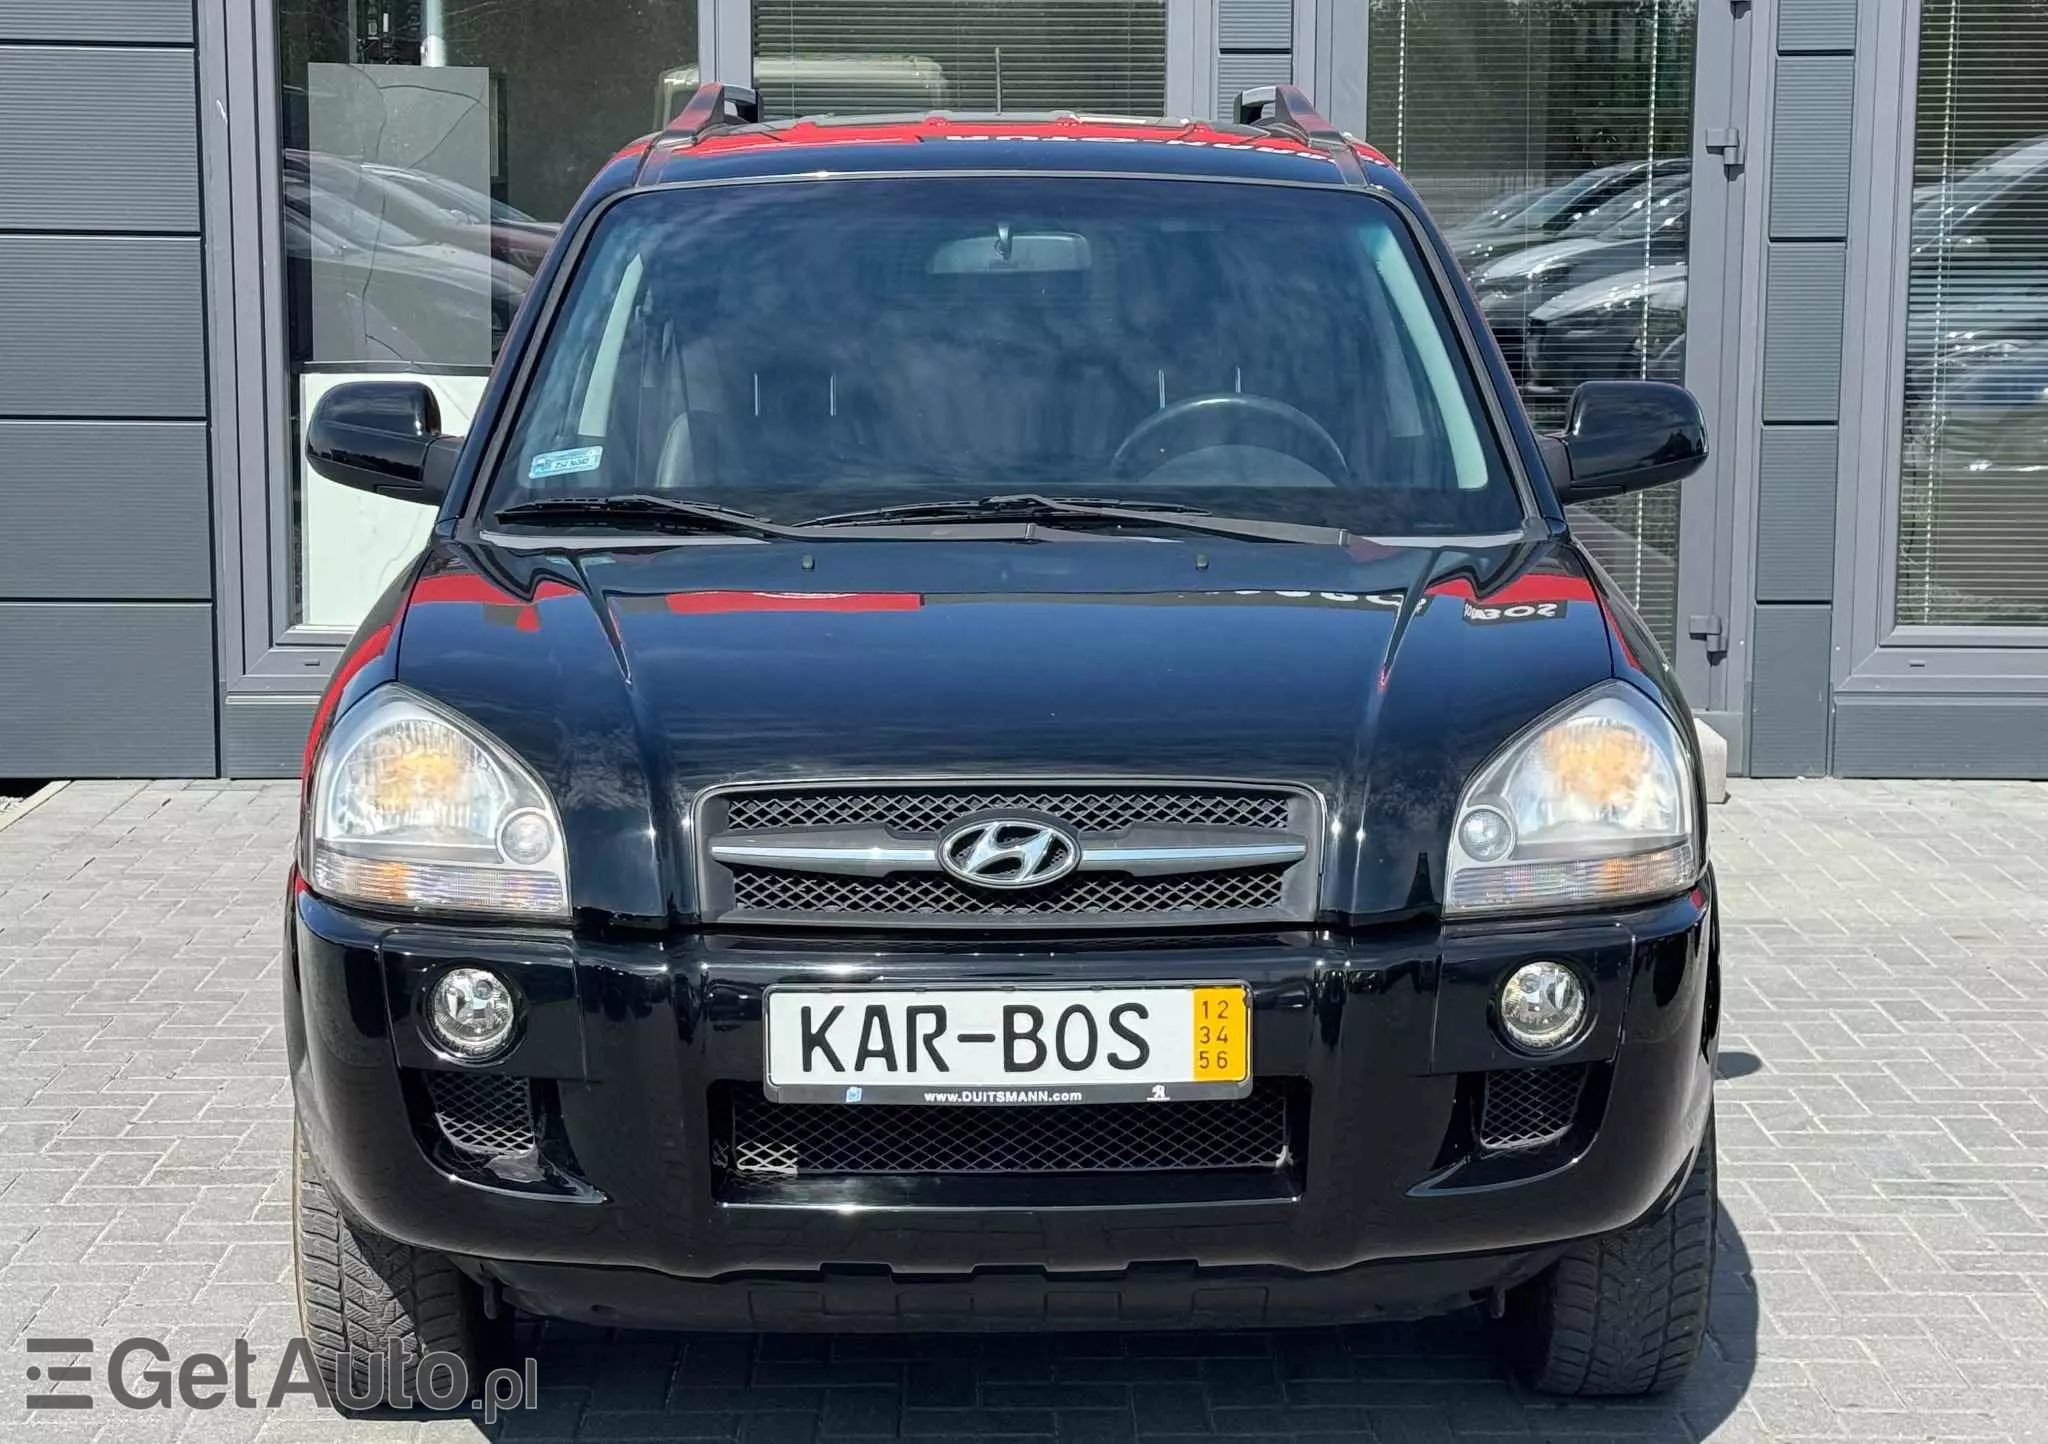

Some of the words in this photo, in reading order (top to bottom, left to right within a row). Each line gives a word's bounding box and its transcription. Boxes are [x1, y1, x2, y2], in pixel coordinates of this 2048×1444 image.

[1202, 999, 1230, 1020] 12
[800, 1003, 1151, 1073] KAR-BOS
[1199, 1025, 1230, 1045] 34
[1199, 1050, 1229, 1069] 56
[923, 1090, 1083, 1104] www.DUITSMANN.com
